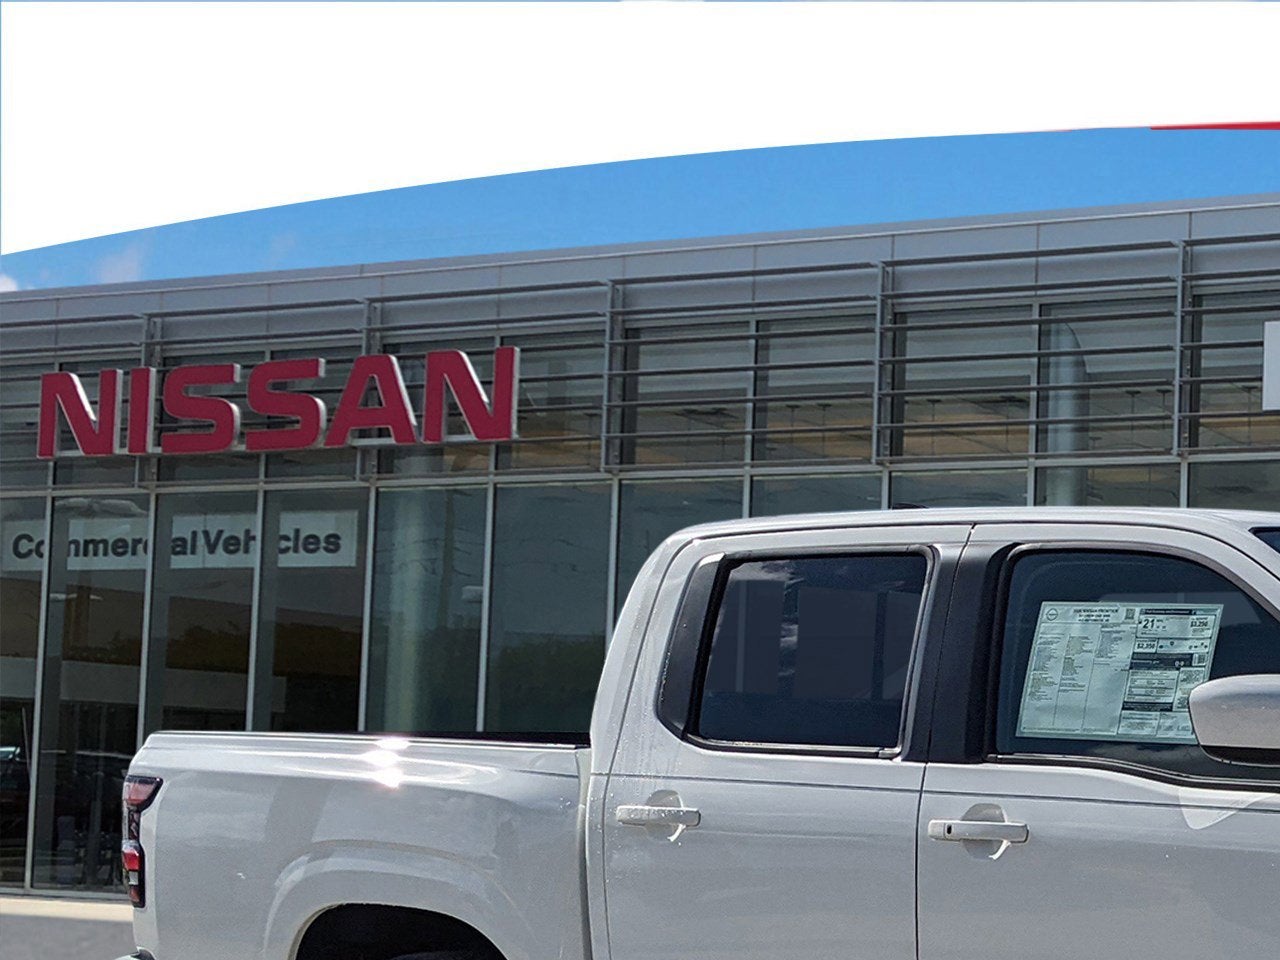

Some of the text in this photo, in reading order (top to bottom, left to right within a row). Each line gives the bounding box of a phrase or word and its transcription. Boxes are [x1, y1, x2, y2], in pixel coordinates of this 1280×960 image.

[37, 346, 521, 459] NISSAN
[12, 529, 342, 559] Commeral Vehcles
[1143, 618, 1155, 629] 21
